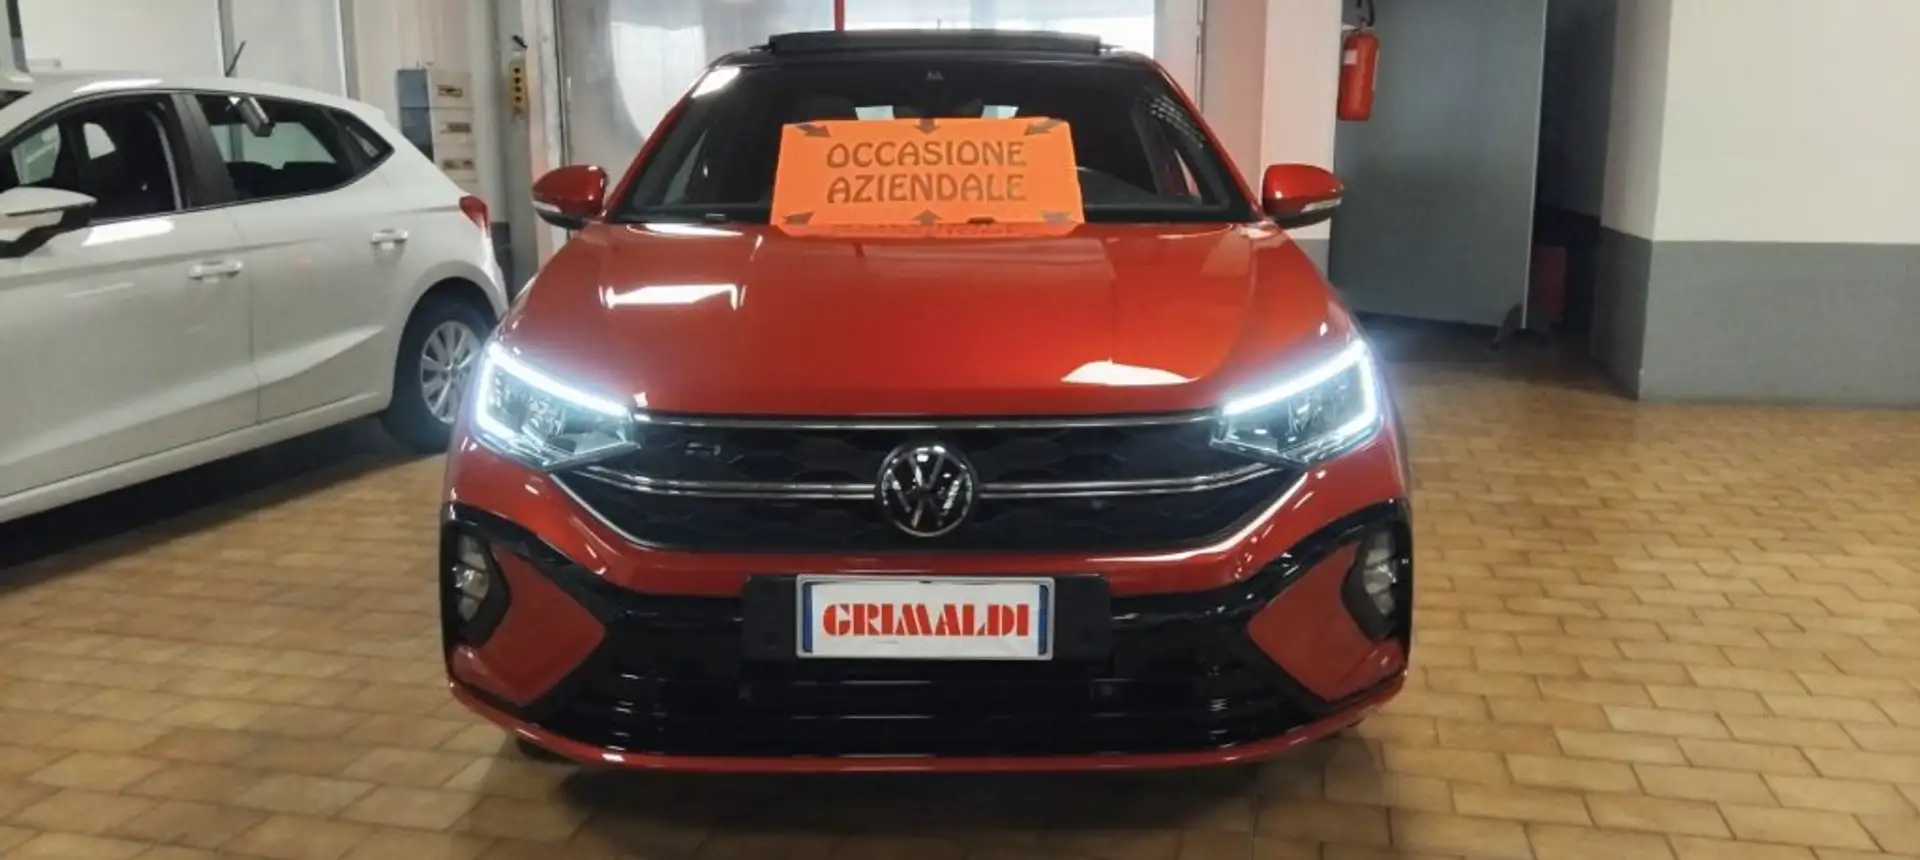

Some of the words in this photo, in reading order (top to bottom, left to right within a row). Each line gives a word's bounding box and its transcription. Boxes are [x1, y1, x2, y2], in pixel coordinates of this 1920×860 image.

[826, 141, 1027, 168] OCCASIONE
[827, 174, 1027, 203] AZIENDALE
[823, 603, 1030, 636] GRIMALDI
